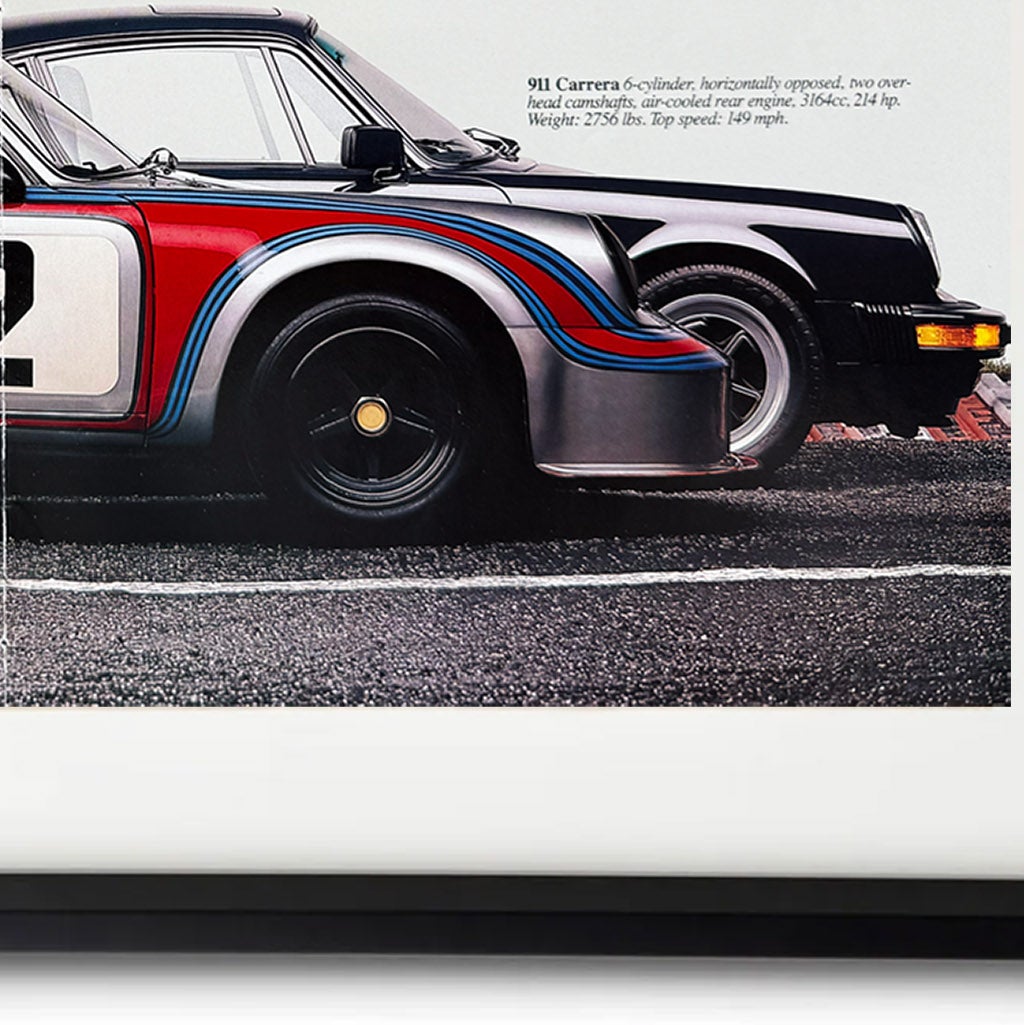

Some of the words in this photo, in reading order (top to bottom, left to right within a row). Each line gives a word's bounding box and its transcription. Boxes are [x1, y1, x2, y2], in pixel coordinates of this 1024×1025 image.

[528, 77, 551, 91] 911
[556, 77, 620, 91] Carrera
[623, 76, 696, 94] 6-cylinder,
[700, 76, 781, 91] horizontally
[784, 78, 844, 92] opposed,
[849, 78, 875, 89] two
[877, 79, 911, 89] over-
[527, 95, 563, 109] head
[565, 94, 637, 110] camshafts,
[641, 94, 712, 108] air-cooled
[715, 98, 745, 108] rear
[748, 98, 796, 110] engine,
[800, 92, 850, 109] 3164cc,
[854, 92, 877, 107] 214
[880, 92, 900, 110] hp.
[528, 112, 580, 128] Weight:
[584, 111, 618, 126] 2756
[622, 112, 646, 126] lbs.
[650, 112, 675, 128] Top
[677, 111, 722, 129] speed:
[728, 111, 752, 126] 149
[754, 111, 789, 128] mph.
